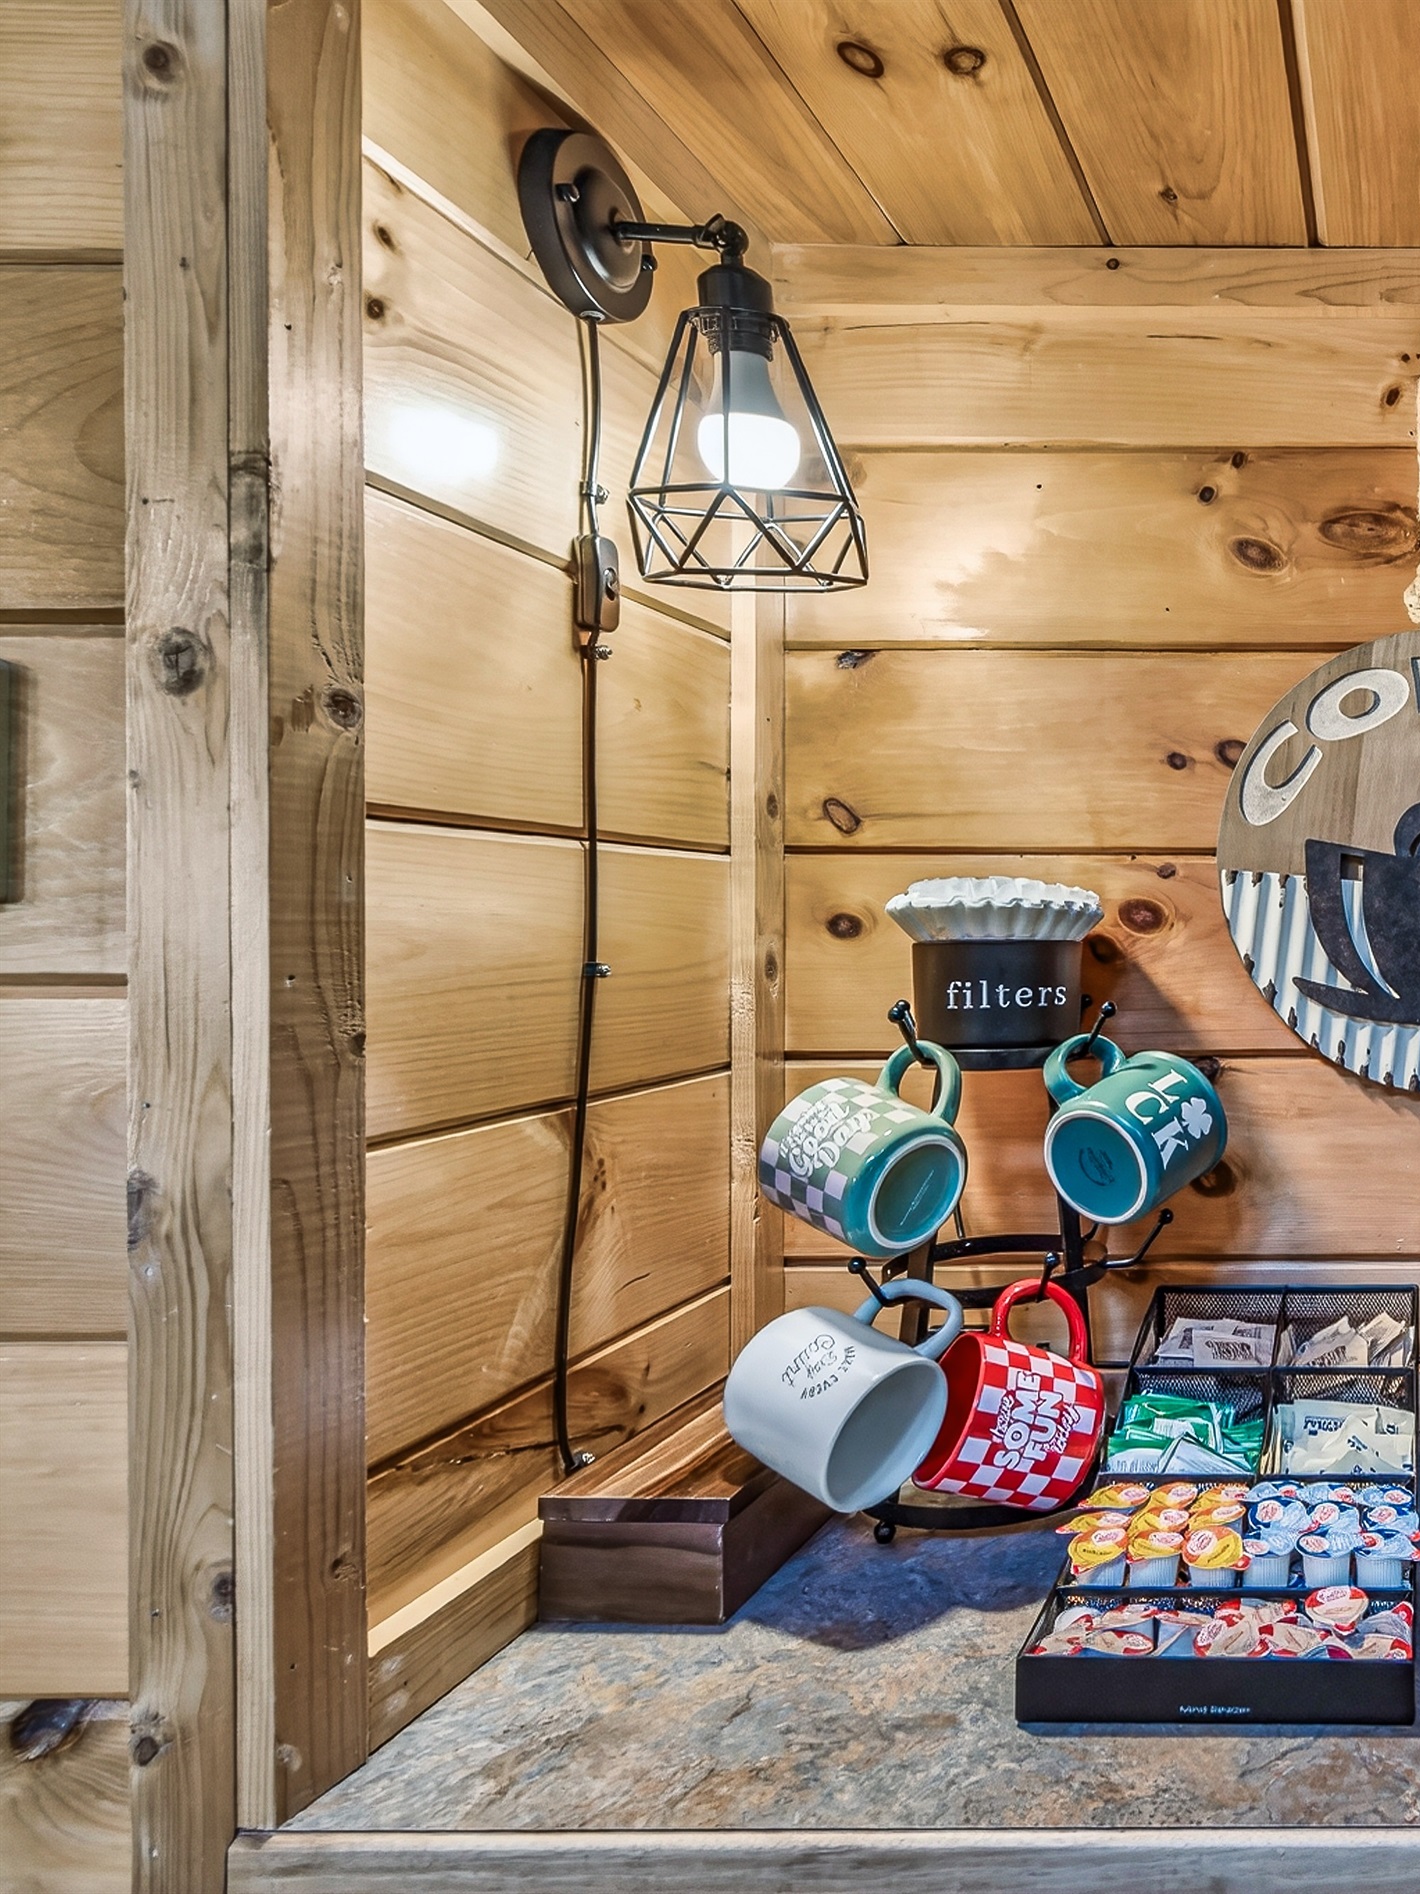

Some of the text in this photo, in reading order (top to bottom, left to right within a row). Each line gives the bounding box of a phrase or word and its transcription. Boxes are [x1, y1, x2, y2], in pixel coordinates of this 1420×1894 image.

[946, 979, 1068, 1010] filters
[993, 1370, 1042, 1470] SOME
[1023, 1391, 1064, 1462] FUN
